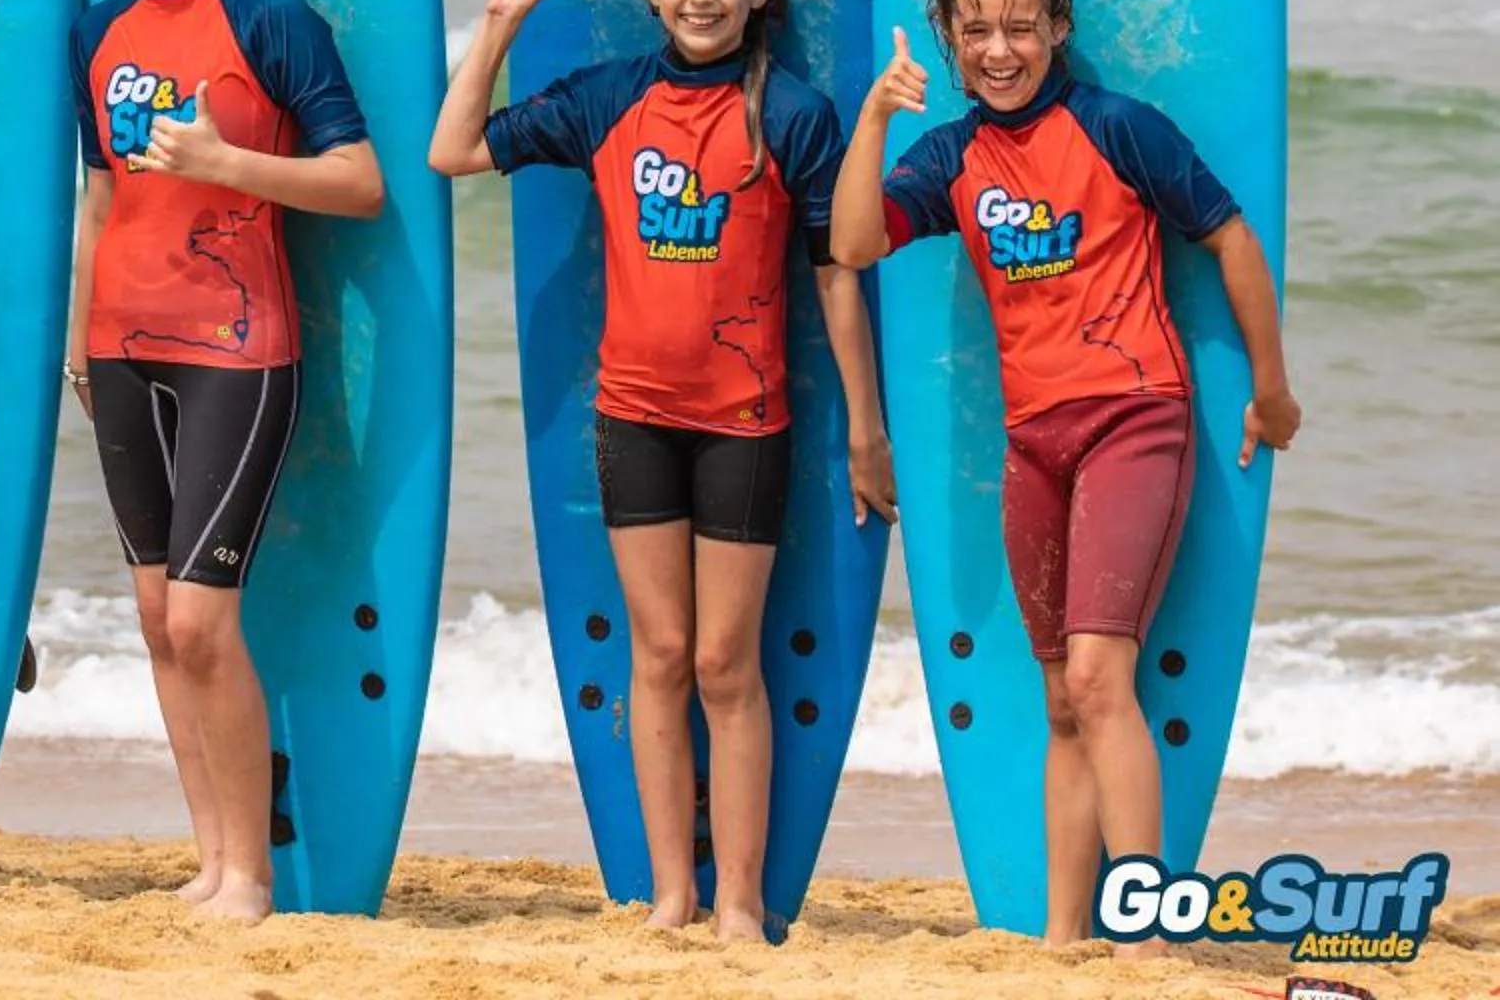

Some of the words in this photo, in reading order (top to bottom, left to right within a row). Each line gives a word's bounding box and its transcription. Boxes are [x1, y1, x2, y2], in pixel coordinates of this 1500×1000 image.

[107, 66, 176, 110] Go&
[633, 150, 699, 206] Go&
[640, 192, 725, 240] Surf
[977, 188, 1051, 231] Go&
[649, 239, 719, 260] Labenne
[990, 214, 1077, 265] Surf
[1007, 258, 1075, 281] Labenne
